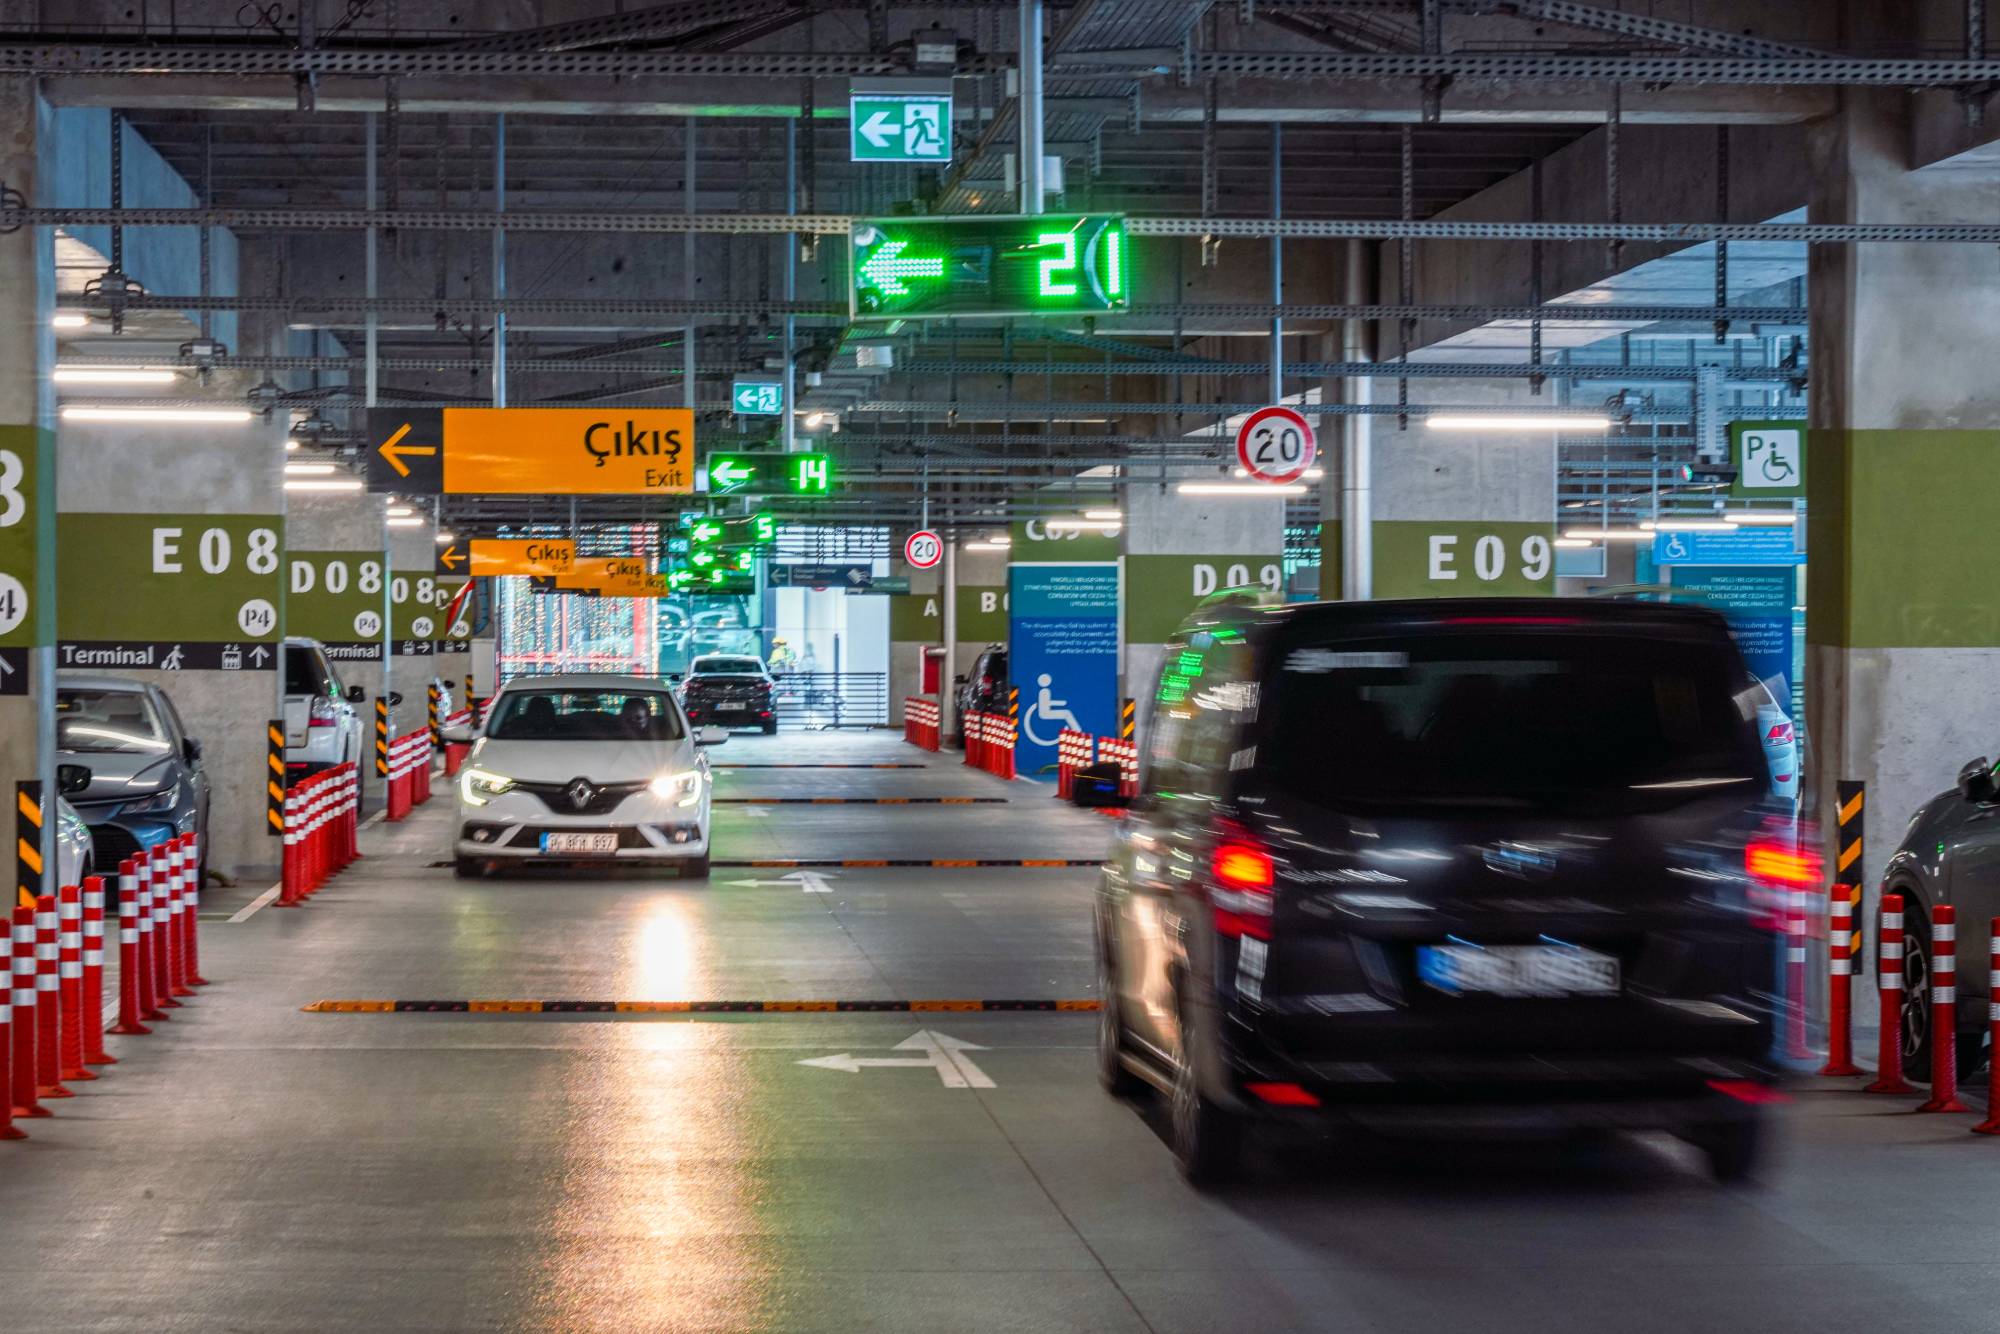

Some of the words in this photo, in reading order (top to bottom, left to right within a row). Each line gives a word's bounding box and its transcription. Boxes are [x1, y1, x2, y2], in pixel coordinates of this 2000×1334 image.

[1038, 231, 1121, 296] 21
[583, 420, 683, 468] Çıkış
[1254, 427, 1301, 464] 20
[1746, 435, 1764, 461] P
[645, 469, 683, 488] Exit
[798, 459, 828, 490] 14
[757, 516, 773, 539] 5
[526, 544, 569, 567] Çıkış
[913, 540, 935, 558] 20
[551, 564, 570, 573] Exit
[605, 561, 642, 579] Çıkış
[245, 608, 270, 628] P4
[358, 617, 377, 631] P4
[415, 621, 430, 633] P4
[61, 645, 155, 666] Terminal
[322, 643, 381, 659] erminal
